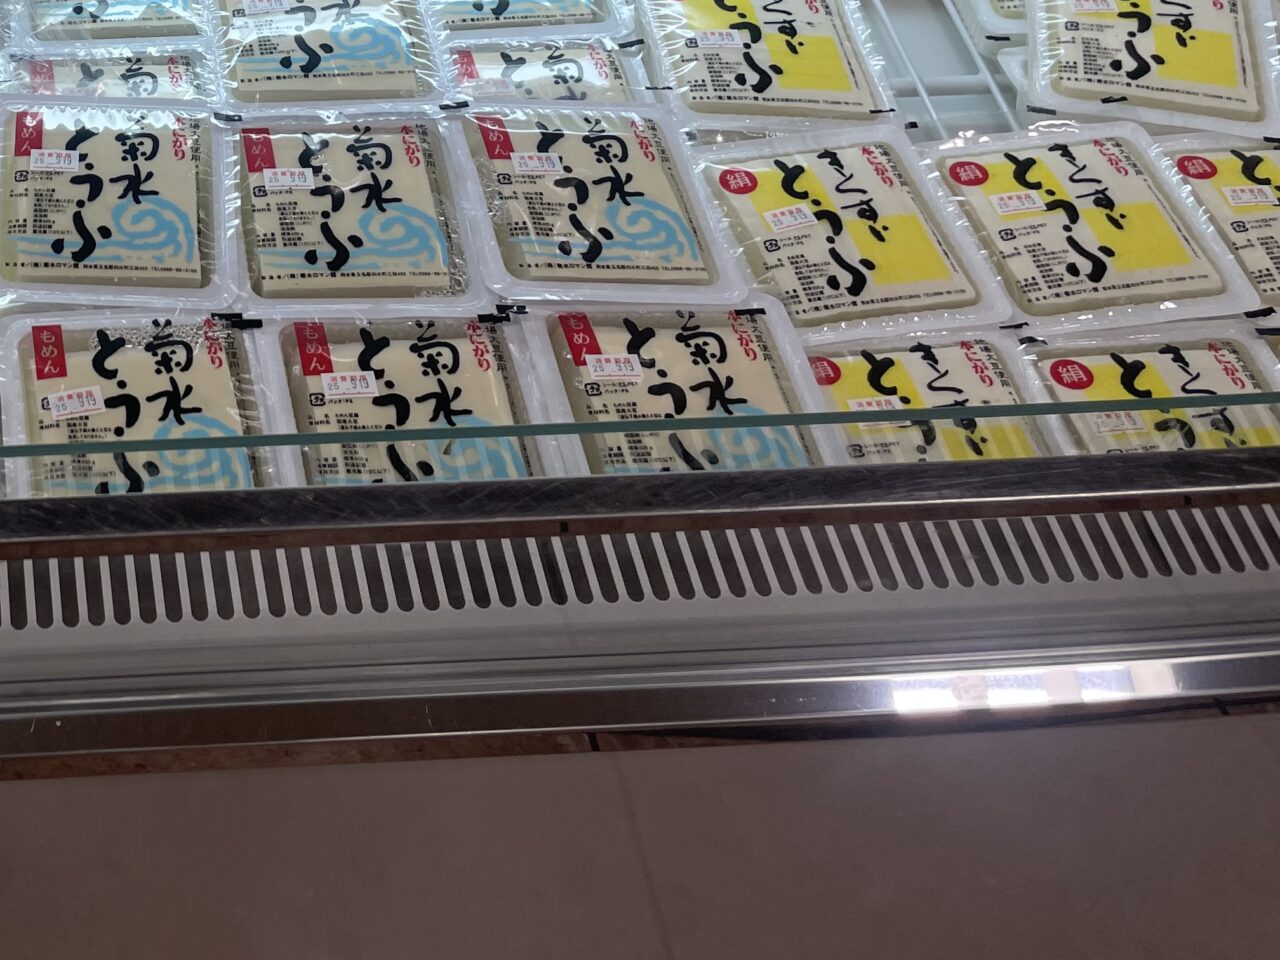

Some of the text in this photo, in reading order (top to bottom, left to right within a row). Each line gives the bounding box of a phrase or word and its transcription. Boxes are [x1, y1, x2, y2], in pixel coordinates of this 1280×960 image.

[725, 172, 752, 190] 絹
[956, 163, 985, 183] 絹
[1183, 158, 1213, 177] 絹
[40, 330, 59, 374] もめん
[304, 326, 325, 371] もめん
[675, 310, 748, 415] 菊水
[144, 318, 202, 425] 菊水
[409, 320, 472, 426] 菊水
[1058, 364, 1087, 384] 絹
